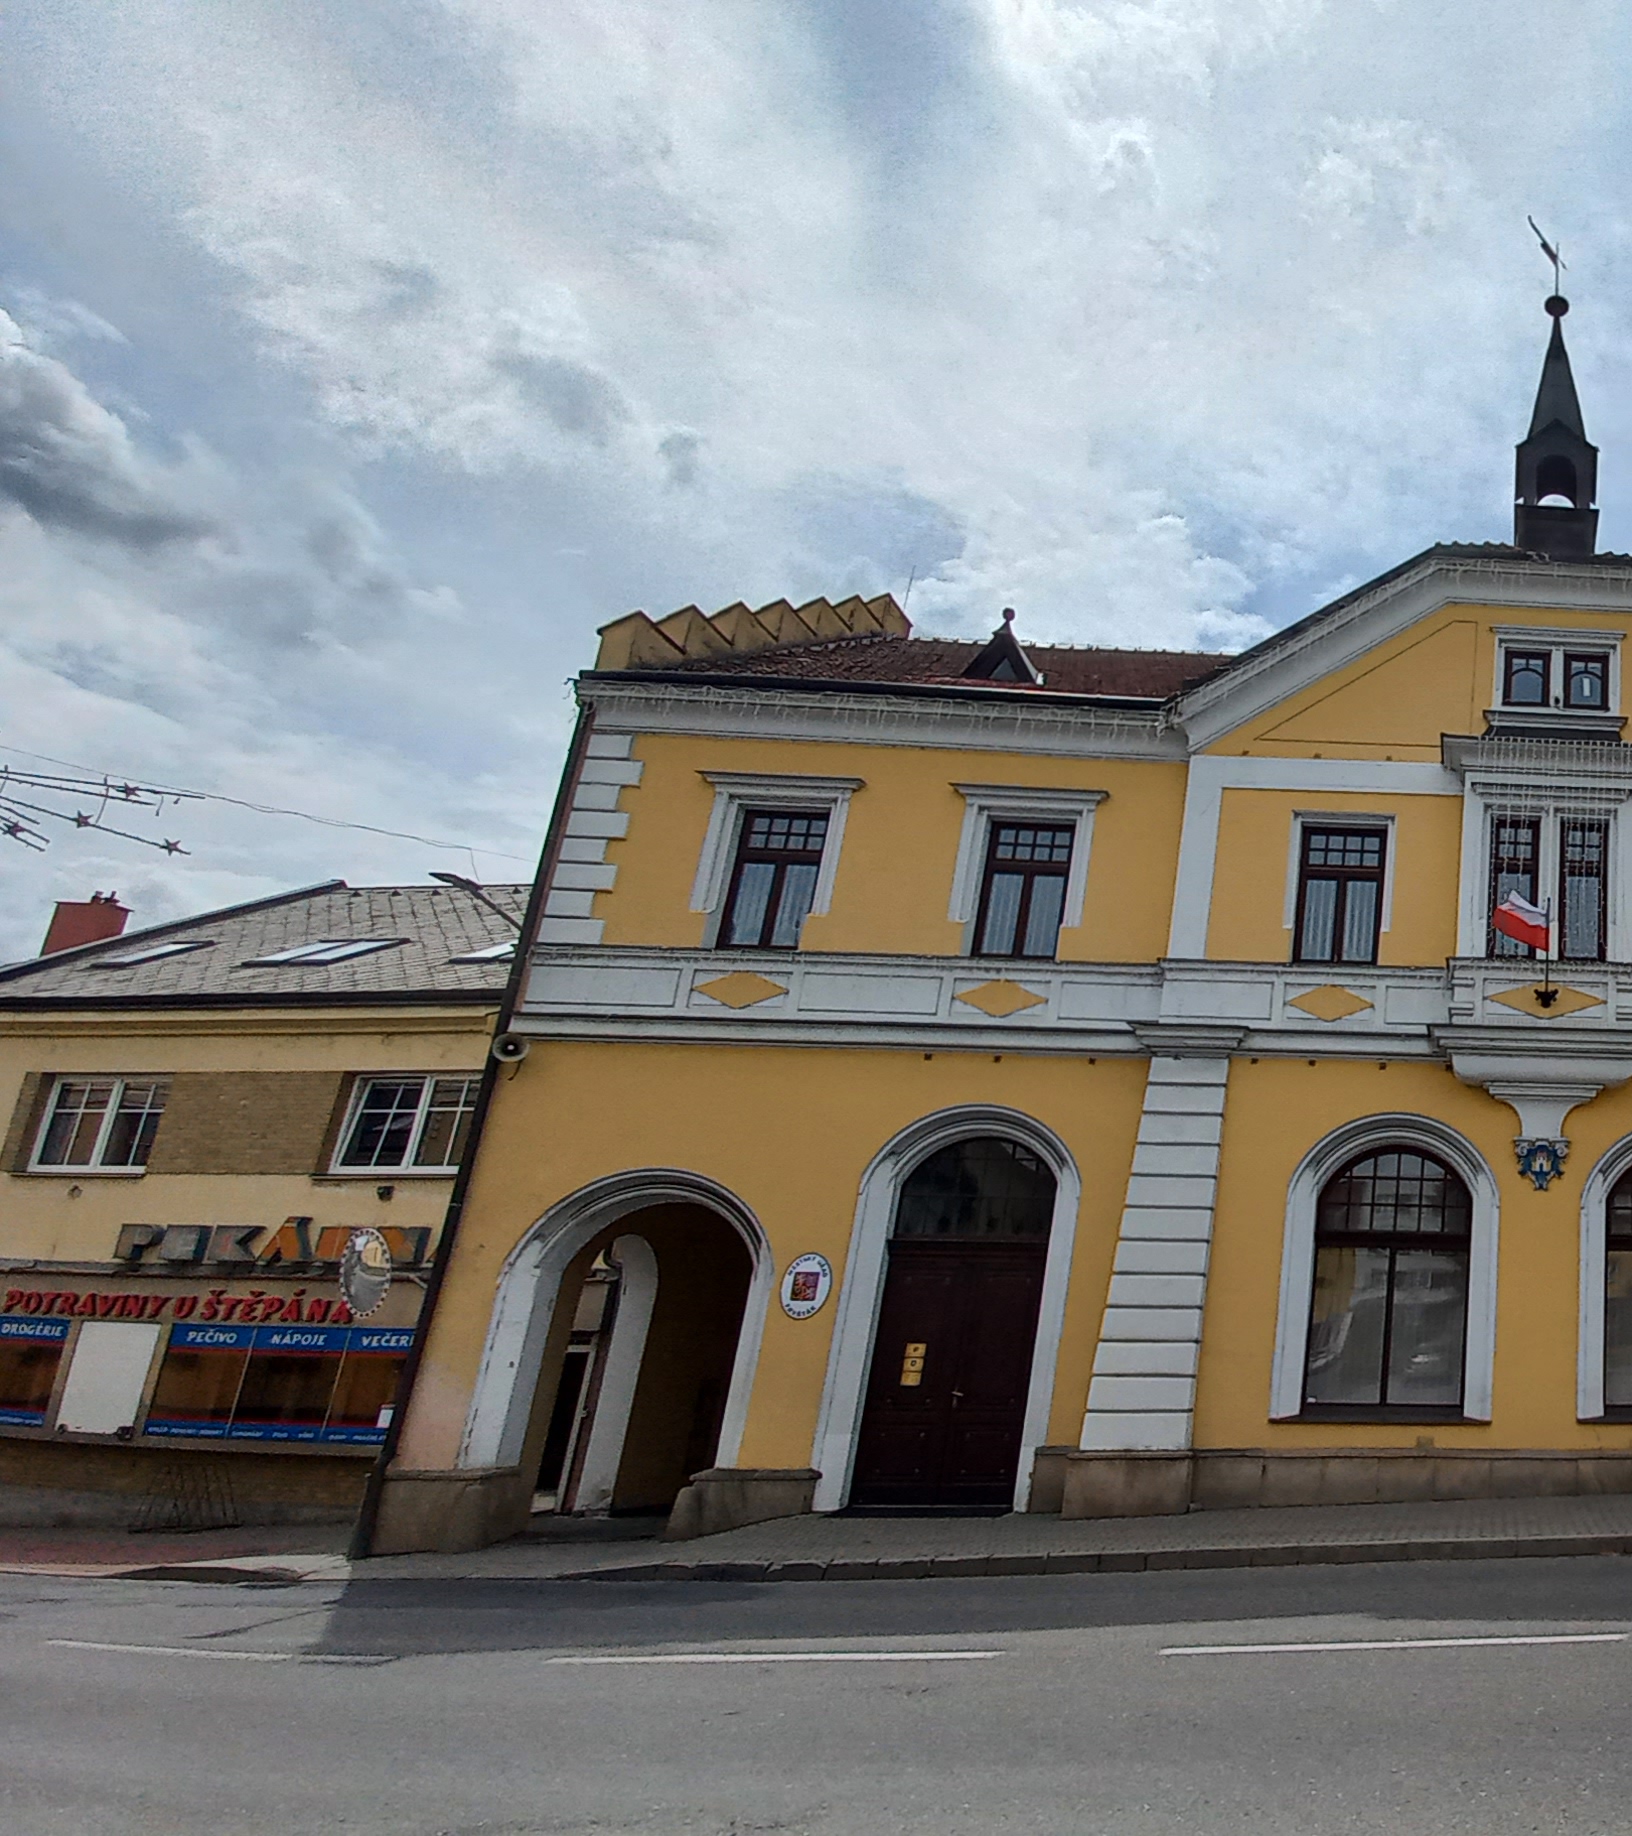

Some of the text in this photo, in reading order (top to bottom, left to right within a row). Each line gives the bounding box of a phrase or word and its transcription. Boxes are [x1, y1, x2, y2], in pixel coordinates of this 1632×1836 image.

[2, 1288, 353, 1324] POTRAVINY U ŠTĚPÁNA
[1, 1322, 63, 1337] DROGÉRIE
[186, 1328, 238, 1345] PEČIVO
[271, 1329, 328, 1347] NÁPOJE
